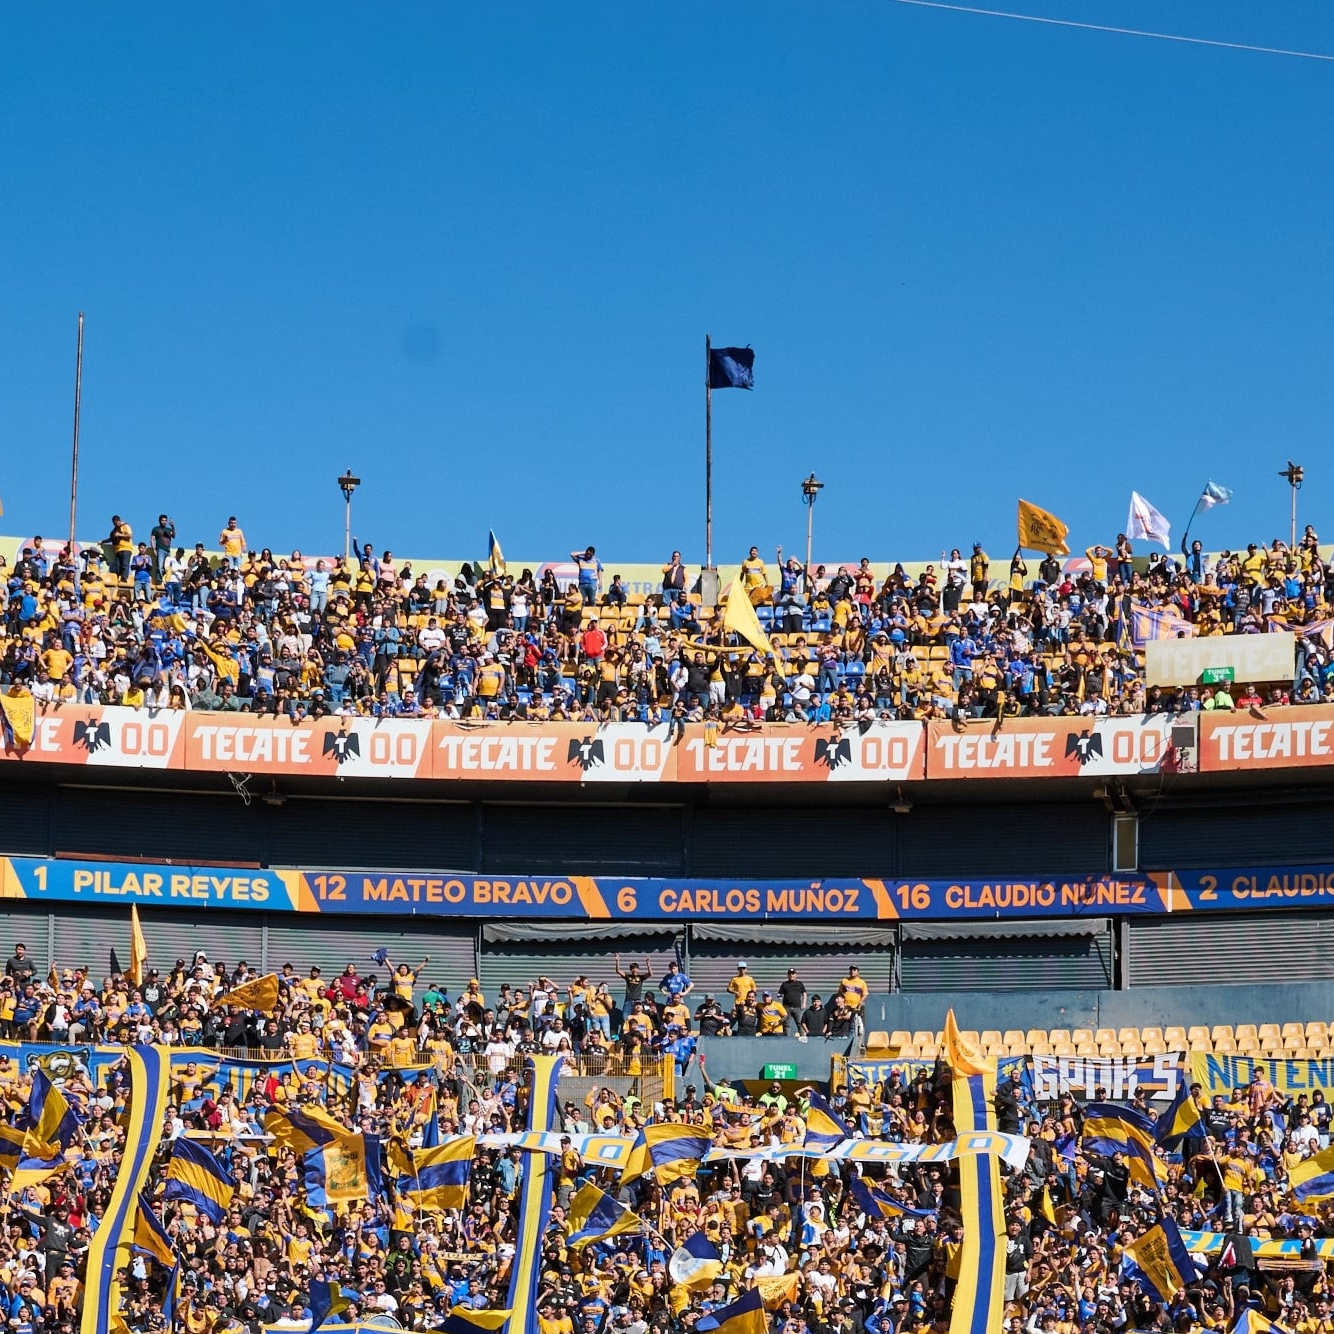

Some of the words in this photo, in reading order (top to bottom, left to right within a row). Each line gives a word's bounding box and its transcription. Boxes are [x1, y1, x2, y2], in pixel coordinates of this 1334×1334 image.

[120, 723, 167, 756] 0.0
[194, 726, 311, 762] TECATE
[371, 732, 416, 764] 0.0
[439, 735, 556, 770] TECATE
[615, 739, 660, 771] 0.0
[686, 738, 803, 771] TECATE
[861, 738, 908, 769] 0.0
[936, 733, 1054, 768] TECATE
[1113, 731, 1160, 763] 0.0
[1211, 722, 1332, 759] TECATE
[34, 868, 46, 890] 1
[73, 870, 162, 897] PILAR
[171, 875, 269, 901] REYES
[315, 876, 346, 900] 12
[363, 879, 465, 904] MATEO
[474, 881, 571, 904] BRAVO
[618, 888, 636, 912] 6
[659, 889, 759, 912] CARLOS
[767, 883, 858, 912] MUÑOZ
[898, 885, 930, 909] 16
[946, 882, 1054, 909] CLAUDIO
[1062, 876, 1146, 905] NÚÑEZ
[1200, 876, 1217, 899] 2
[774, 1071, 786, 1079] 21
